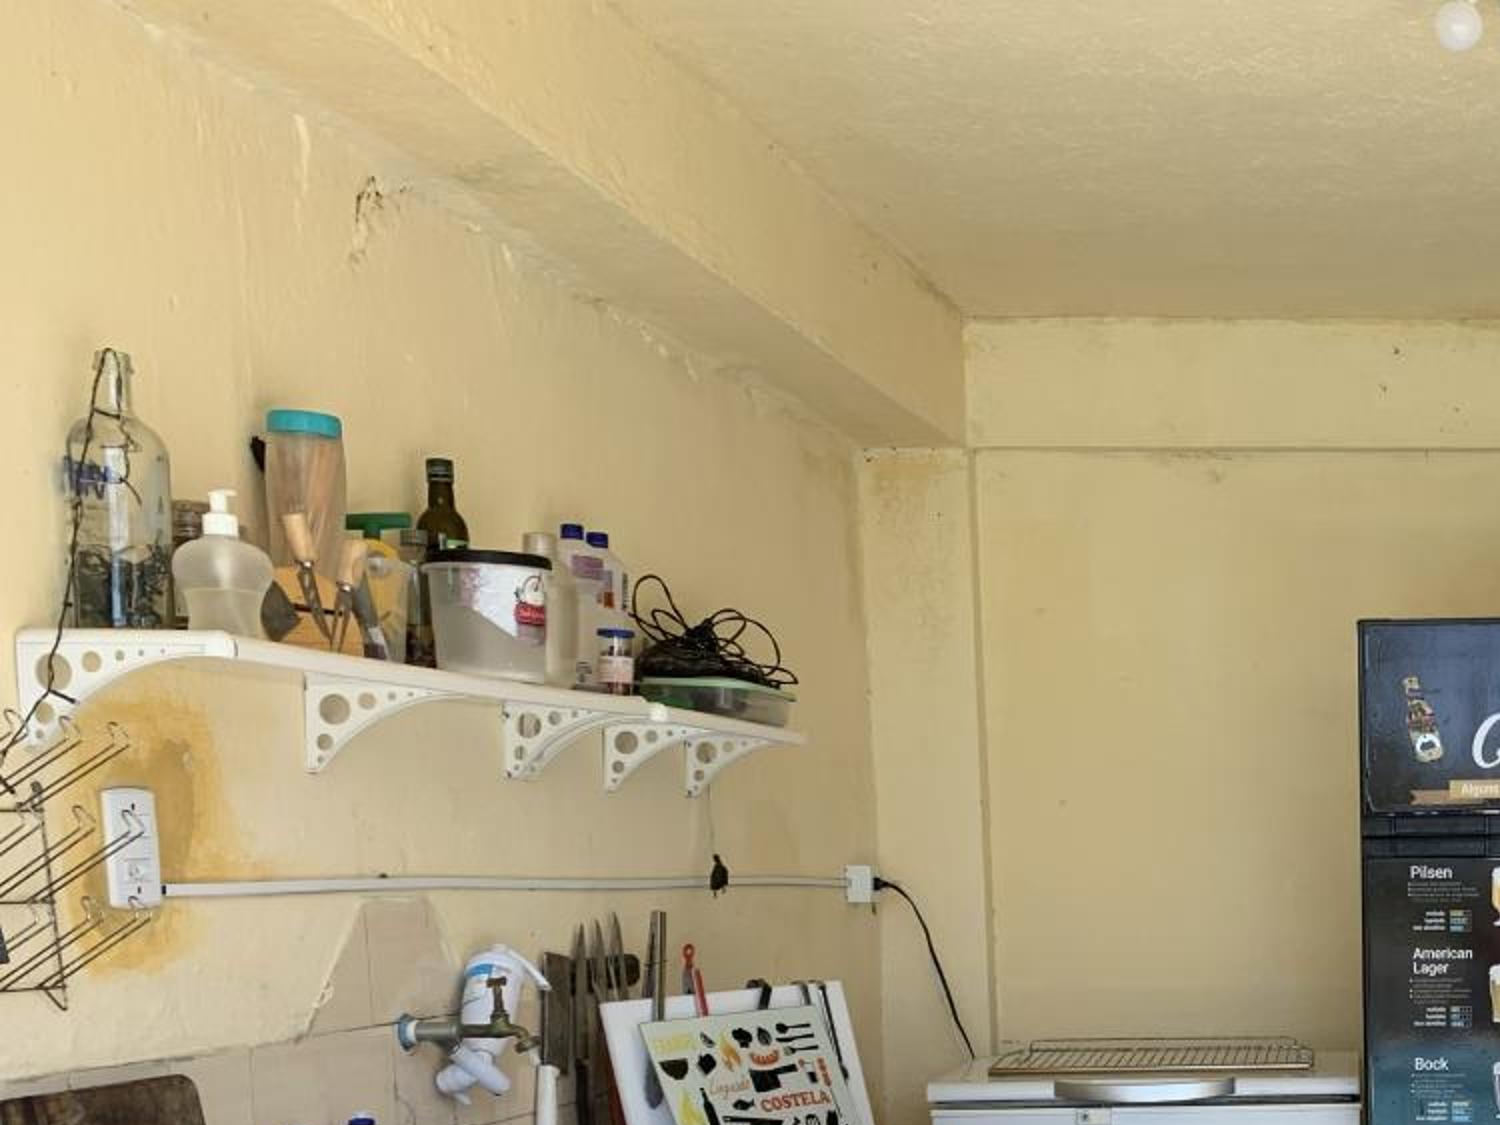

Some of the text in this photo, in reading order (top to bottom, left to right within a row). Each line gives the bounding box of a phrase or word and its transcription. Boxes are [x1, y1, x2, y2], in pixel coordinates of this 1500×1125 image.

[1410, 865, 1453, 879] Pilsen
[1413, 947, 1473, 960] American
[1413, 962, 1449, 976] Lager
[1414, 1057, 1449, 1071] Bock
[760, 1090, 832, 1113] COSTELA
